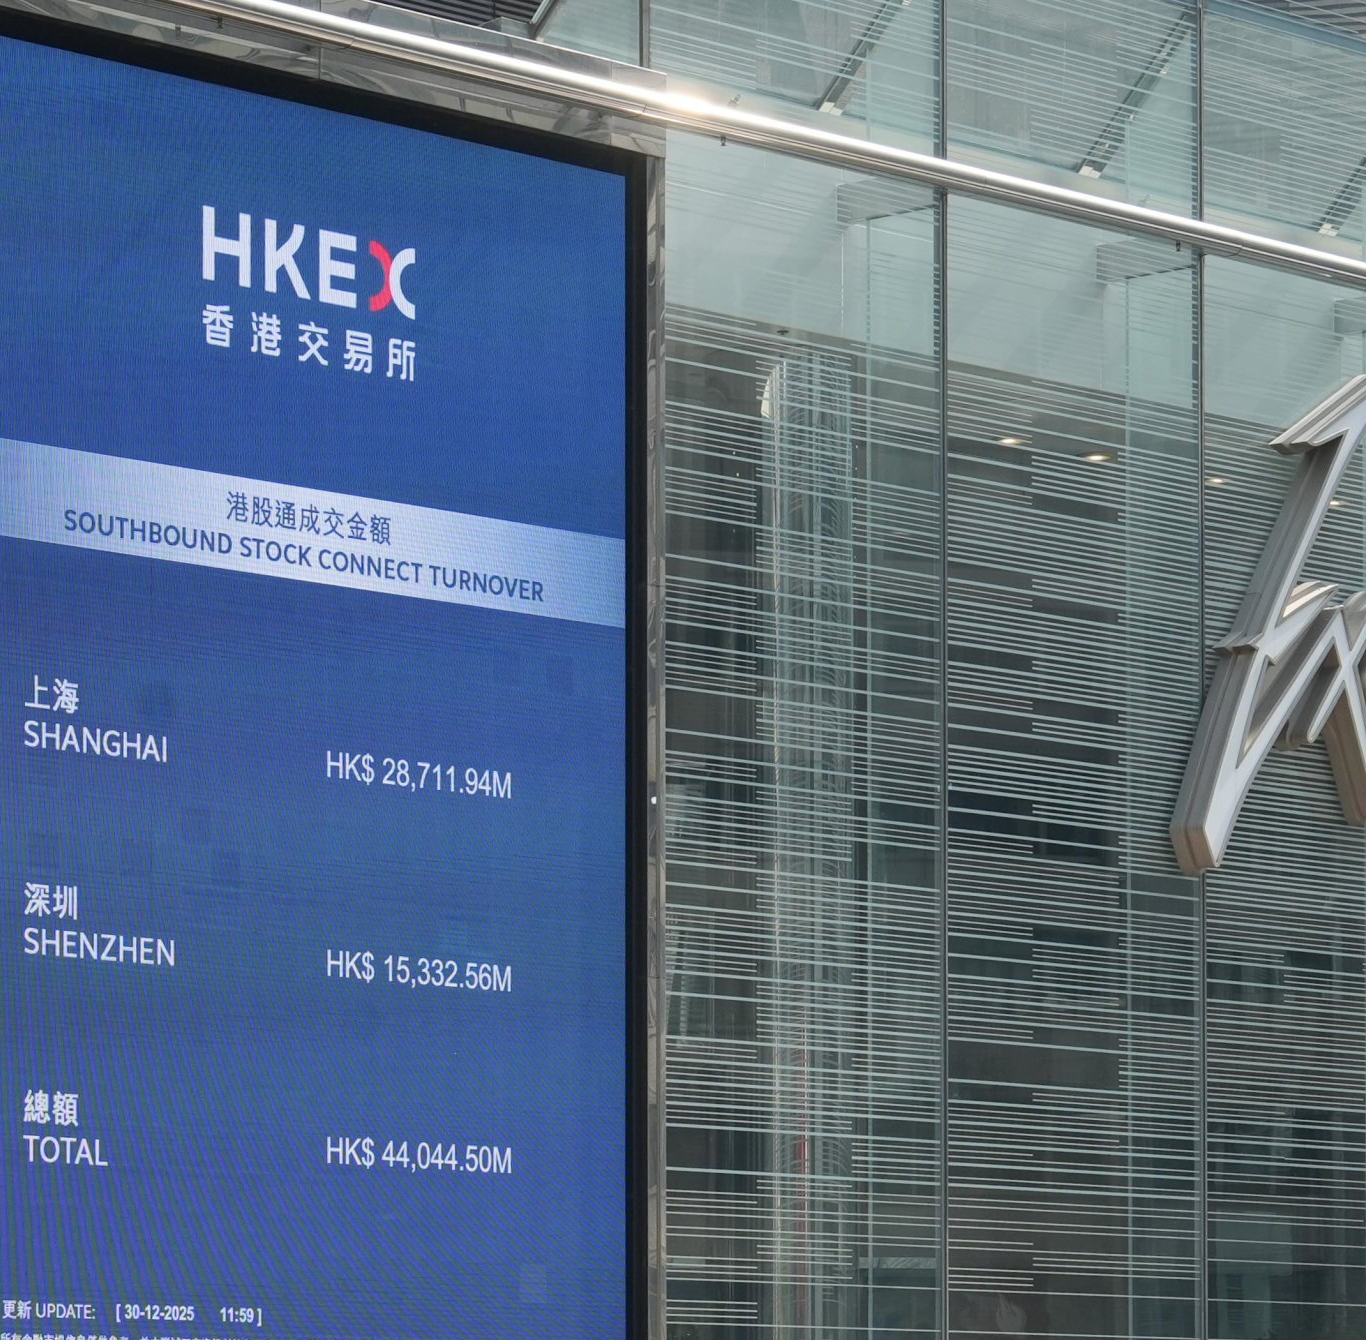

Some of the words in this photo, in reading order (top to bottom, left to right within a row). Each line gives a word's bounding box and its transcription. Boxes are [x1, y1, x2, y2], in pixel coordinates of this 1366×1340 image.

[203, 206, 415, 319] HKEX
[203, 304, 415, 381] 香港交易所
[227, 491, 391, 545] 港股通成交金額
[63, 508, 232, 555] SOUTHBOUND
[240, 537, 311, 566] STOCK
[319, 550, 422, 583] CONNECT
[429, 564, 545, 603] TURNOVER
[25, 675, 79, 713] 上海
[24, 721, 167, 762] SHANGHAI
[327, 751, 374, 785] HK$
[383, 758, 511, 798] 28,711.94M
[24, 882, 77, 920] 深圳
[24, 928, 174, 966] SHENZHEN
[327, 950, 374, 983] HK$
[385, 955, 511, 992] 15,332.56M
[24, 1090, 78, 1126] 總額
[23, 1135, 108, 1166] TOTAL
[327, 1137, 374, 1169] HK$
[382, 1141, 511, 1173] 44,044.50M
[3, 1300, 31, 1319] 更新
[36, 1303, 95, 1319] UPDATE:
[125, 1304, 194, 1320] 30-12-2025
[220, 1307, 254, 1322] 11:59
